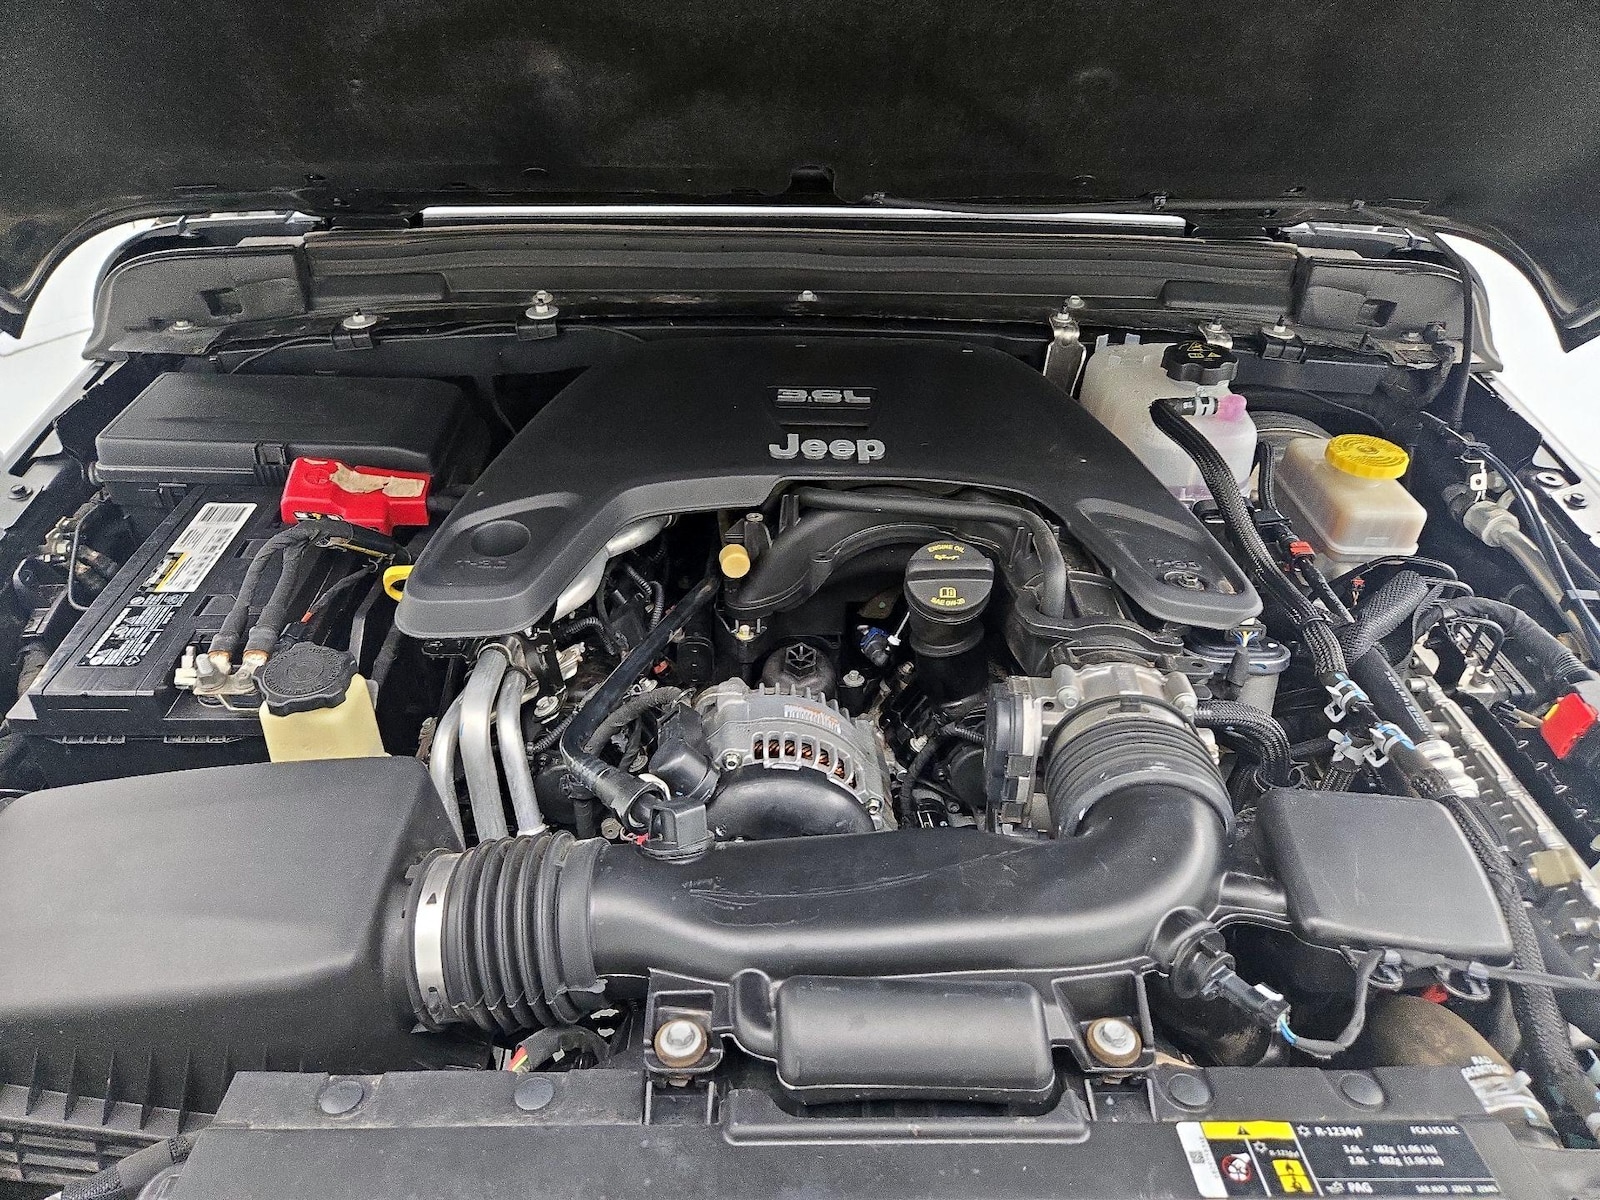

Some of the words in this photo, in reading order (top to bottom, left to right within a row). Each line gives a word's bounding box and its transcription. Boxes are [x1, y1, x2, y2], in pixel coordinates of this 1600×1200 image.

[776, 389, 871, 403] 3.6L
[768, 433, 886, 464] Jeep
[927, 544, 953, 553] ENGINE
[953, 545, 965, 554] OIL
[930, 597, 945, 606] SAE
[1315, 1126, 1363, 1138] R-1234yf
[1409, 1126, 1430, 1135] FCA
[1427, 1126, 1443, 1135] US
[1441, 1126, 1461, 1135] LLC
[1347, 1182, 1373, 1193] PAG
